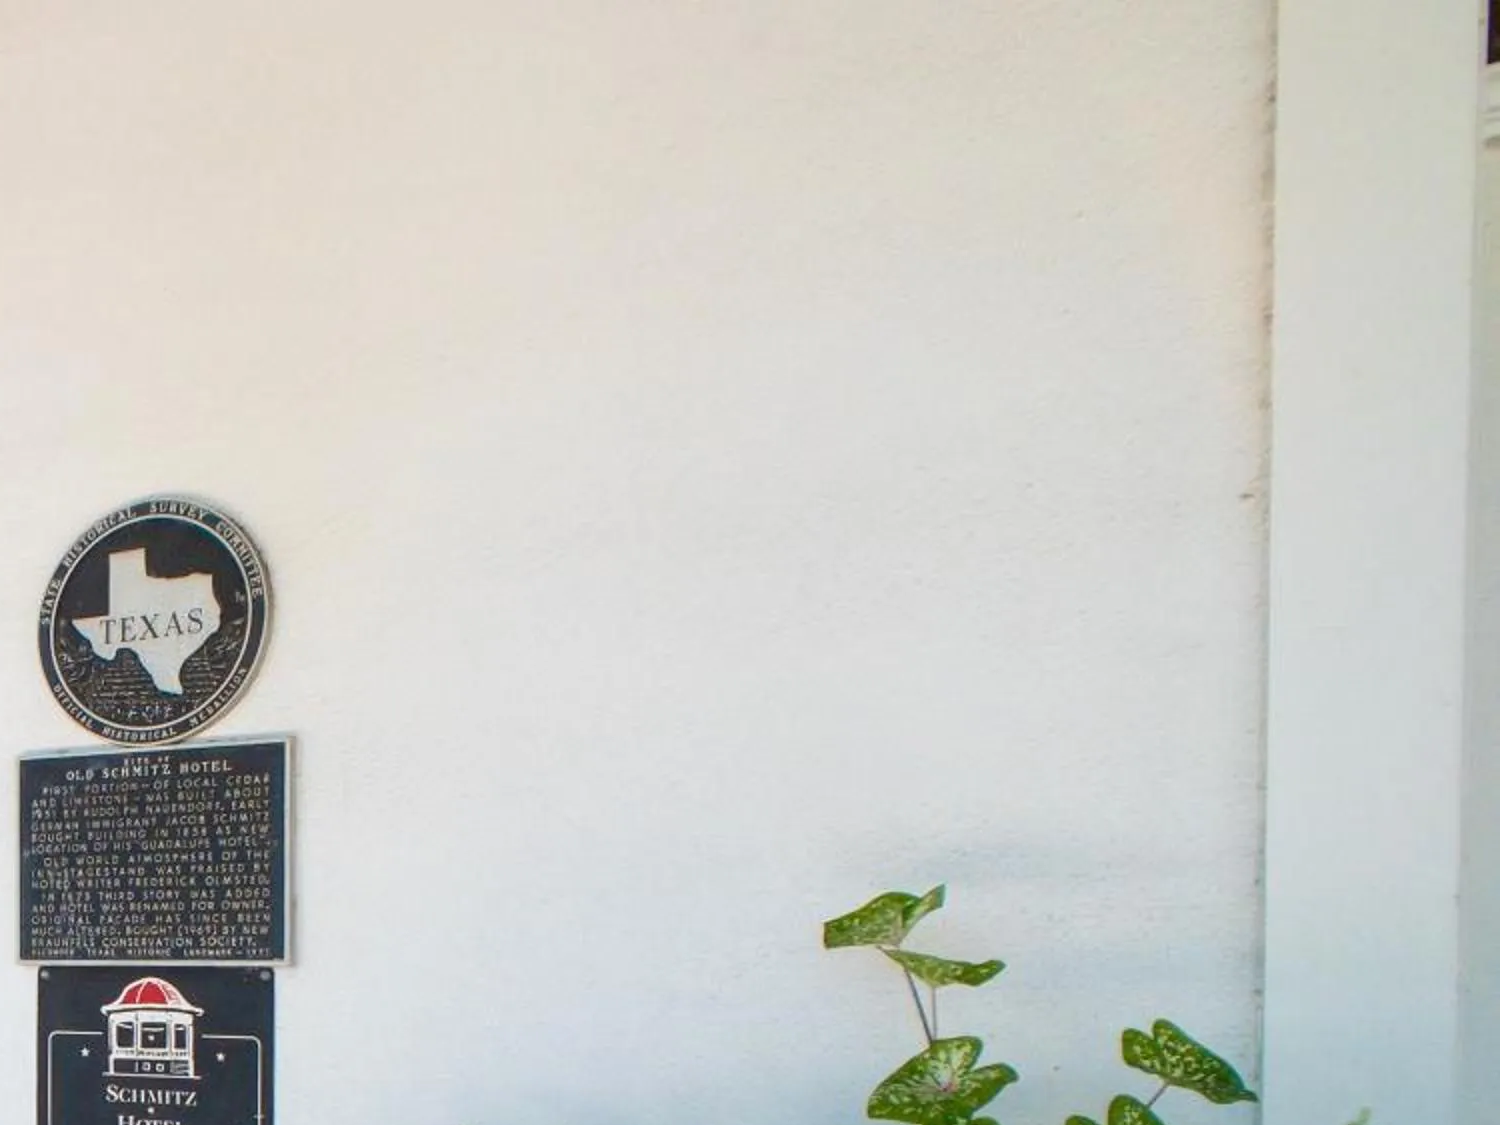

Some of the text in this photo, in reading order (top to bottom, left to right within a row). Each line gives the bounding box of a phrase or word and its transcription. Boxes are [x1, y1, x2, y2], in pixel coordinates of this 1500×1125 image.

[64, 508, 137, 569] HISTORICAL
[150, 501, 207, 521] SURVEY
[216, 521, 264, 599] COMMITTEE
[100, 608, 204, 645] TEXAS
[101, 723, 178, 741] HISTORICAL
[66, 759, 232, 781] OLD SCHMITZ HOTEL
[177, 776, 218, 789] LOCAL
[224, 786, 269, 798] ABOUT
[166, 815, 205, 826] JACOB
[213, 811, 269, 824] SCHMITZ
[106, 1084, 197, 1107] SCHMITZ
